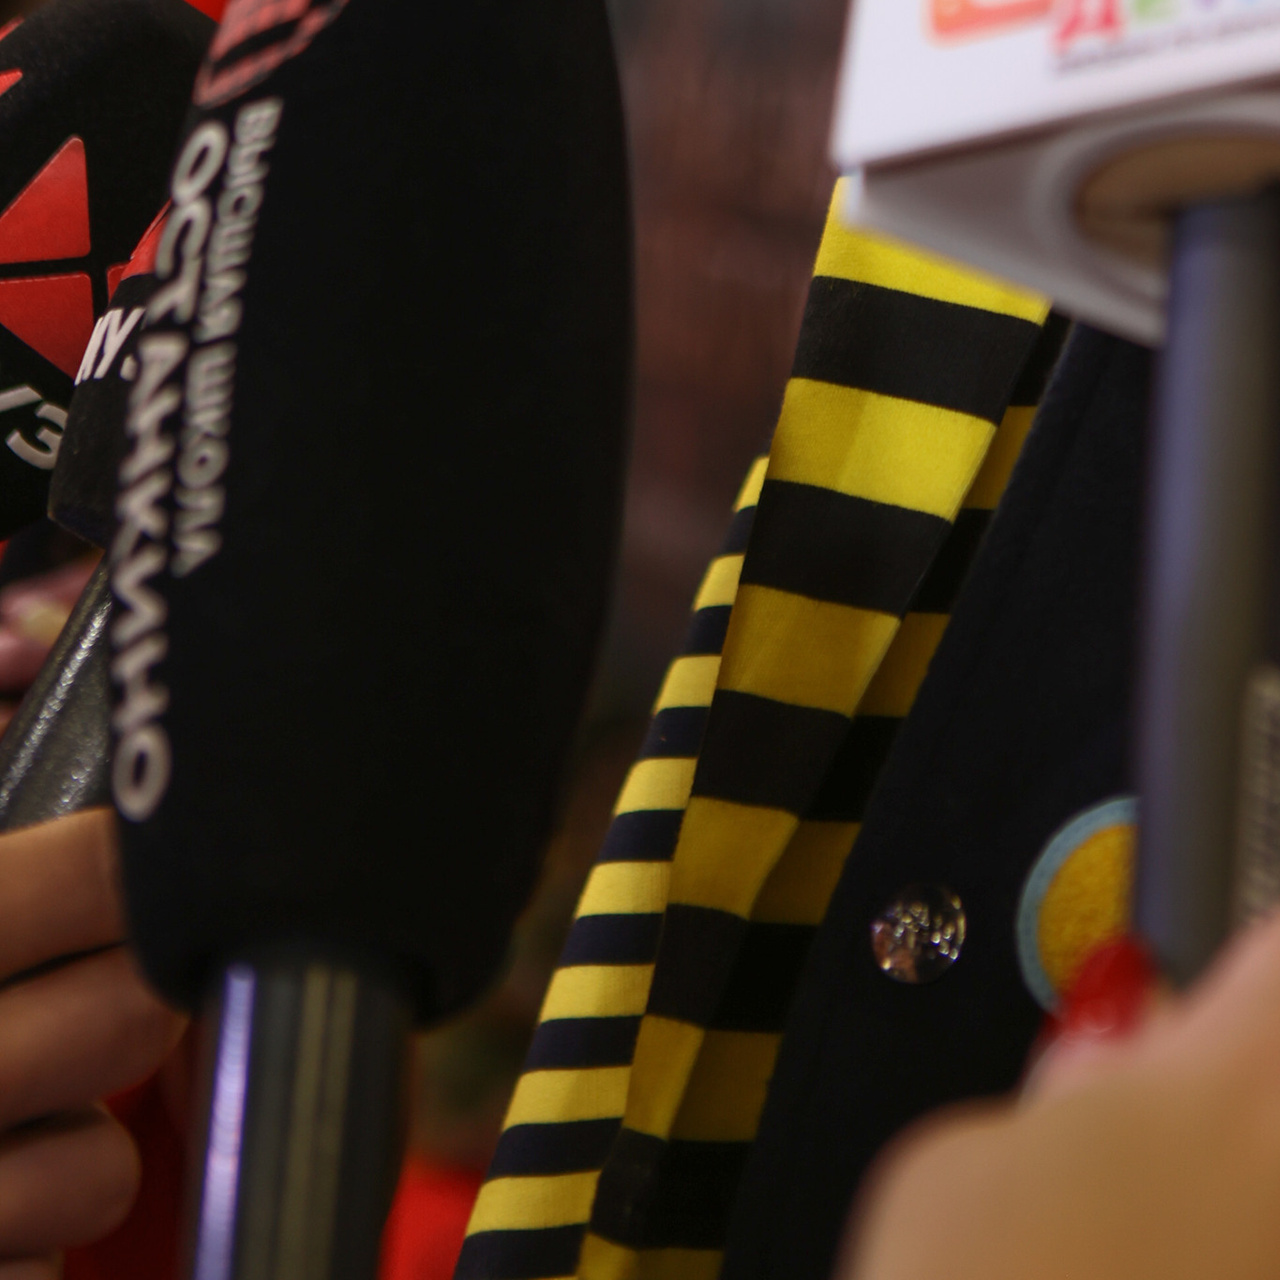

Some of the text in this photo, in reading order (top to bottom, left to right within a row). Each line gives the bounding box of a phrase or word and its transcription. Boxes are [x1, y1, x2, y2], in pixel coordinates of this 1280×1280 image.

[110, 121, 230, 822] ОСТАНКИНО
[170, 97, 284, 578] ВЫСШАЯ ШКОЛА
